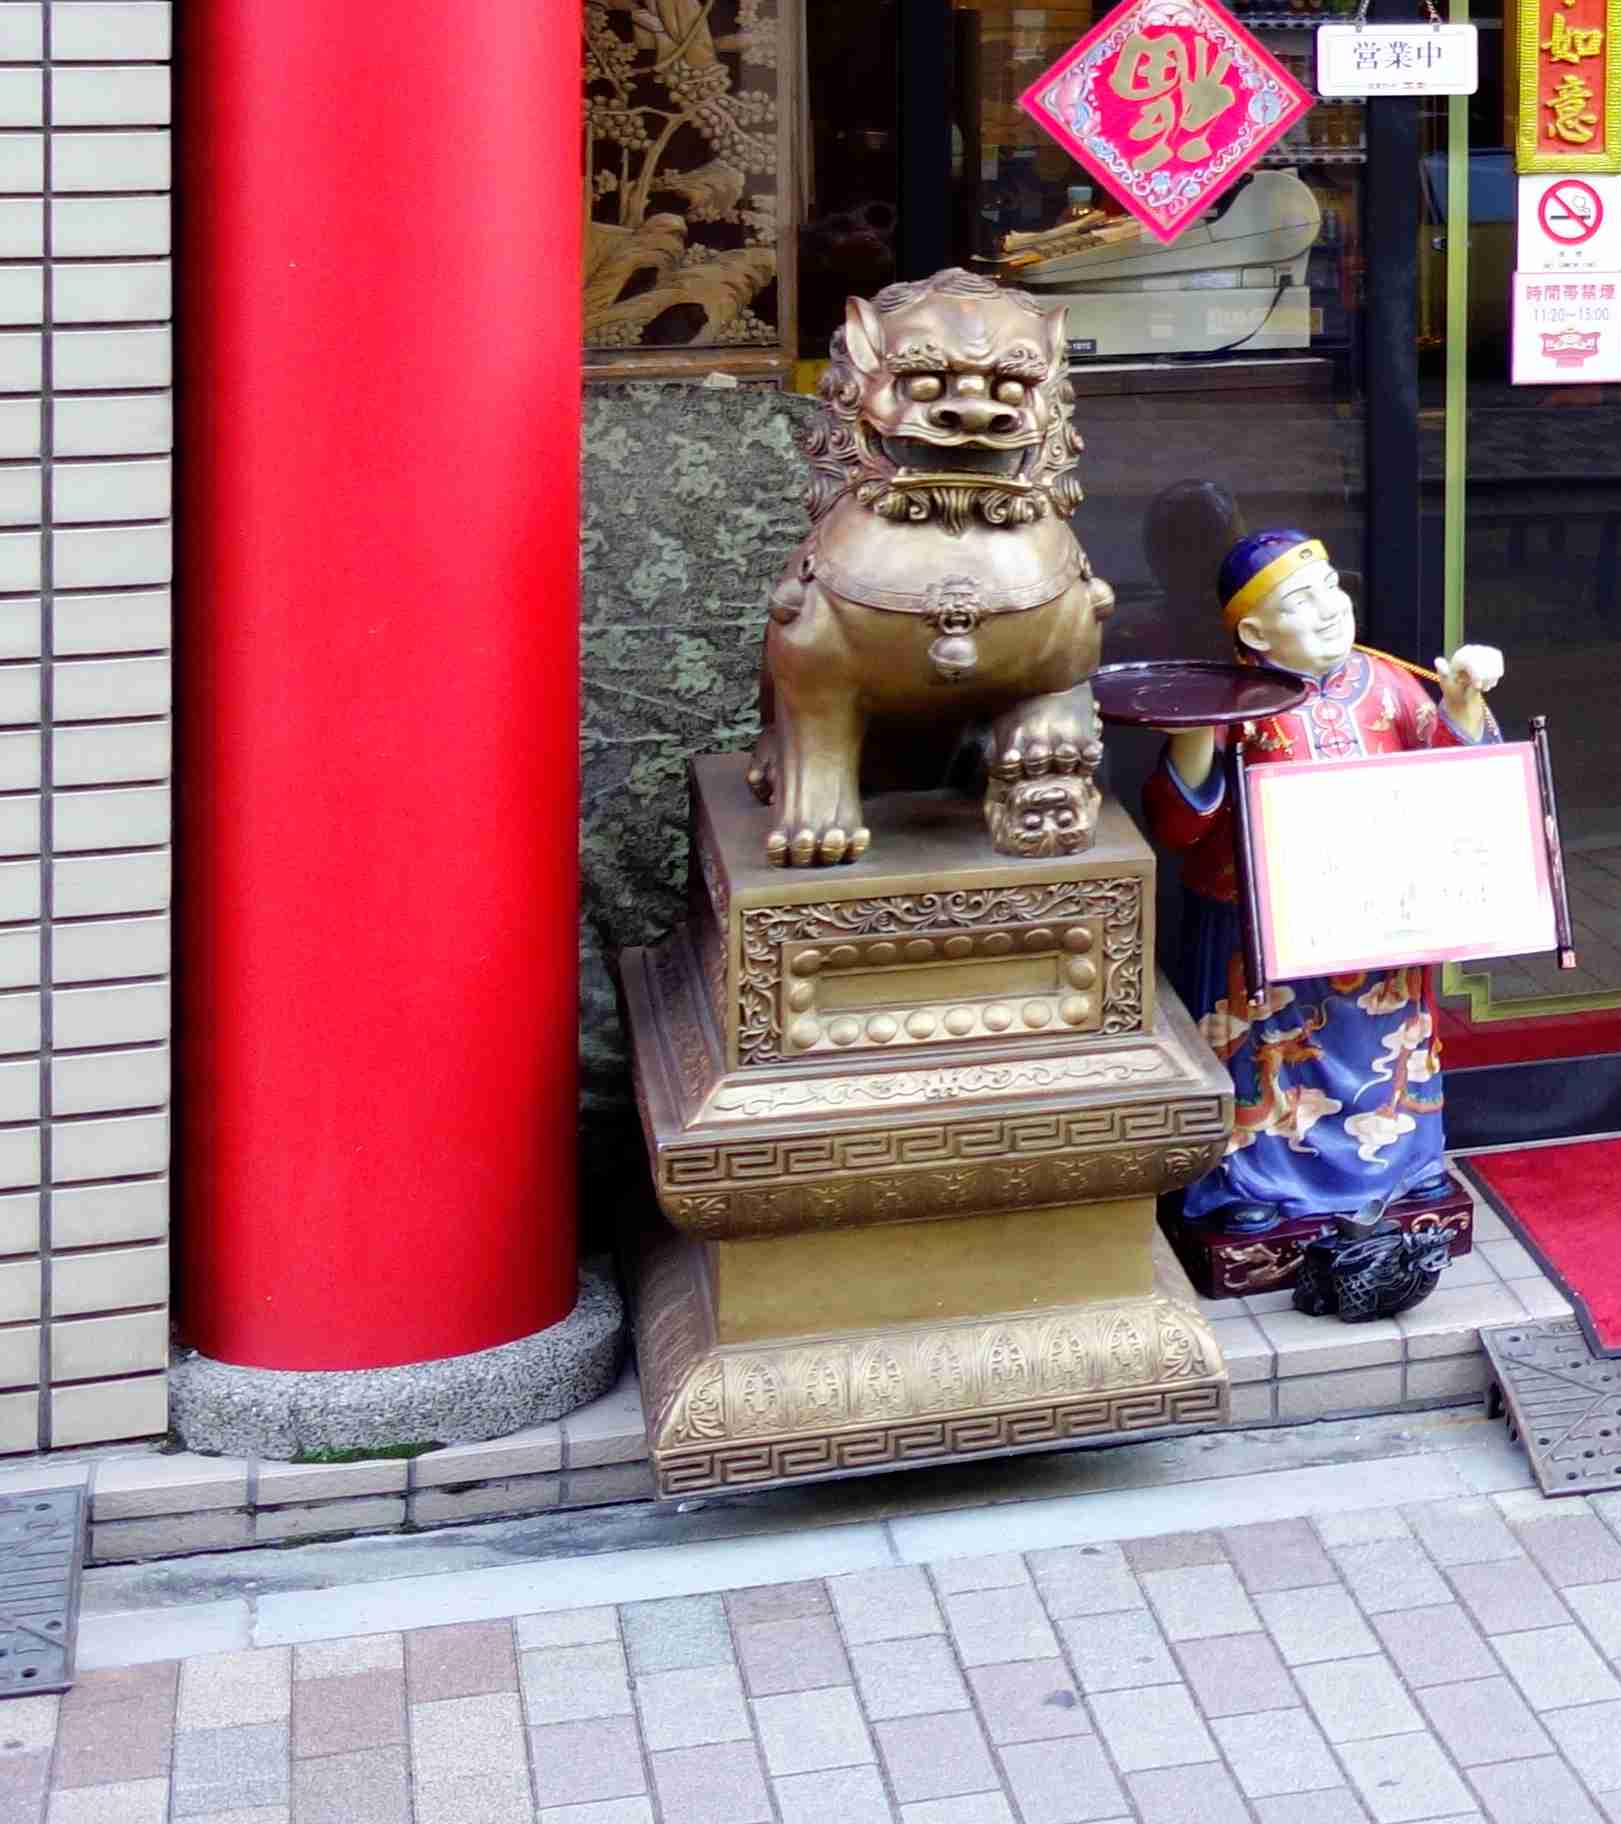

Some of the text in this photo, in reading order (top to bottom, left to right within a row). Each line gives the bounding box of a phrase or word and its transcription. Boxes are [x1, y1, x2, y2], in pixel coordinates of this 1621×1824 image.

[1353, 40, 1442, 71] 営業中
[1526, 283, 1616, 301] 時間帯禁煙
